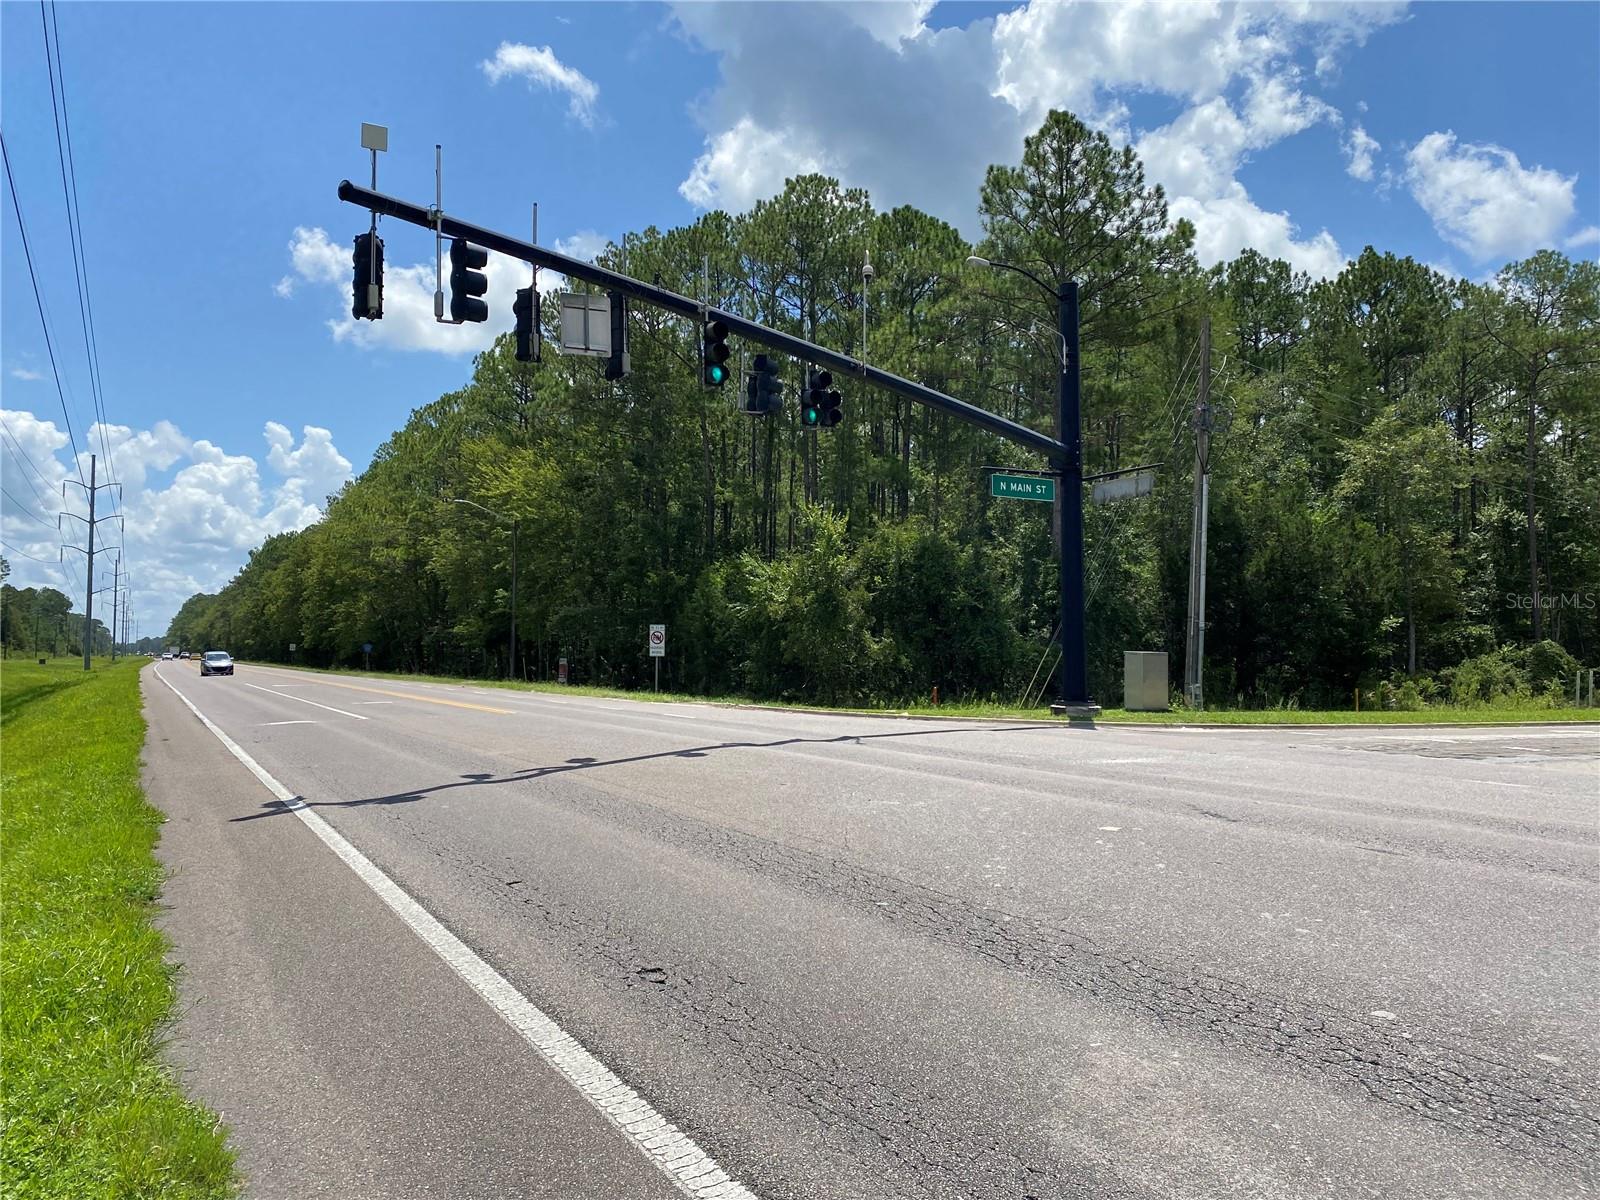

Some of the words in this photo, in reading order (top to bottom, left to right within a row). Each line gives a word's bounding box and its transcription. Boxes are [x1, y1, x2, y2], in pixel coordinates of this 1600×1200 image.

[1000, 481, 1006, 490] N
[1010, 482, 1032, 493] MAIN
[1036, 485, 1047, 494] ST
